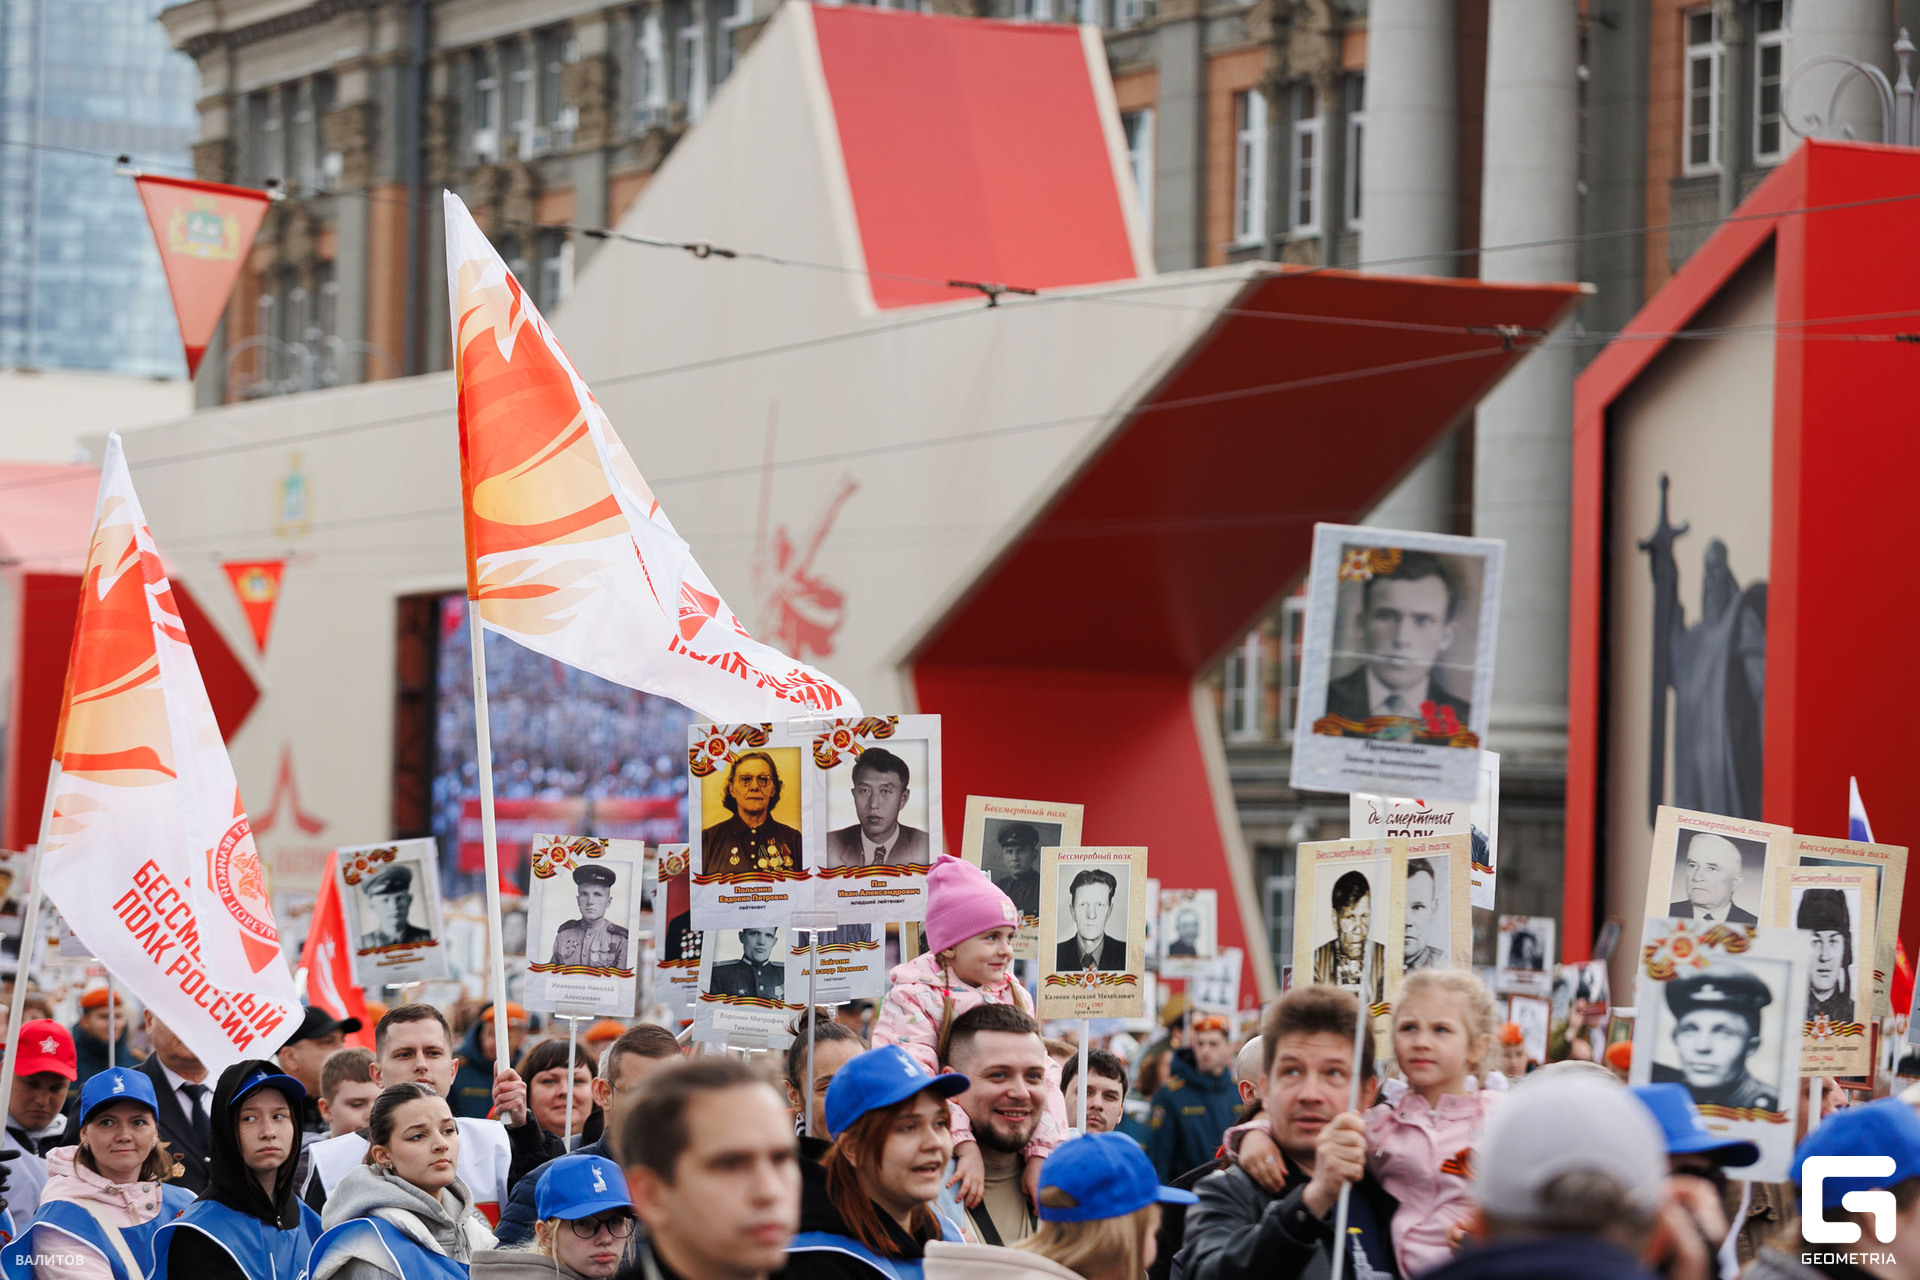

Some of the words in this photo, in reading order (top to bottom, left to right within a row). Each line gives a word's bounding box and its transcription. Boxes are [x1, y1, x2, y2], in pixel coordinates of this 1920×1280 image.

[1368, 800, 1455, 828] бесмертный
[1057, 852, 1112, 862] Бессмертный
[1112, 852, 1132, 861] полк
[871, 879, 887, 887] Пак
[838, 889, 858, 898] Иван
[859, 888, 921, 897] Александрович
[719, 895, 751, 904] Евдокия
[751, 894, 789, 902] Петровна
[133, 858, 288, 1039] БЕССМЫЙ
[112, 888, 177, 965] ПОЛК
[165, 955, 256, 1053] РОССИИ
[801, 967, 836, 976] Алсандр
[836, 965, 869, 973] Иванович
[587, 983, 615, 992] Николай
[719, 1012, 749, 1022] Воронин
[750, 1014, 785, 1025] Митрофан
[733, 1024, 769, 1034] Тихонович
